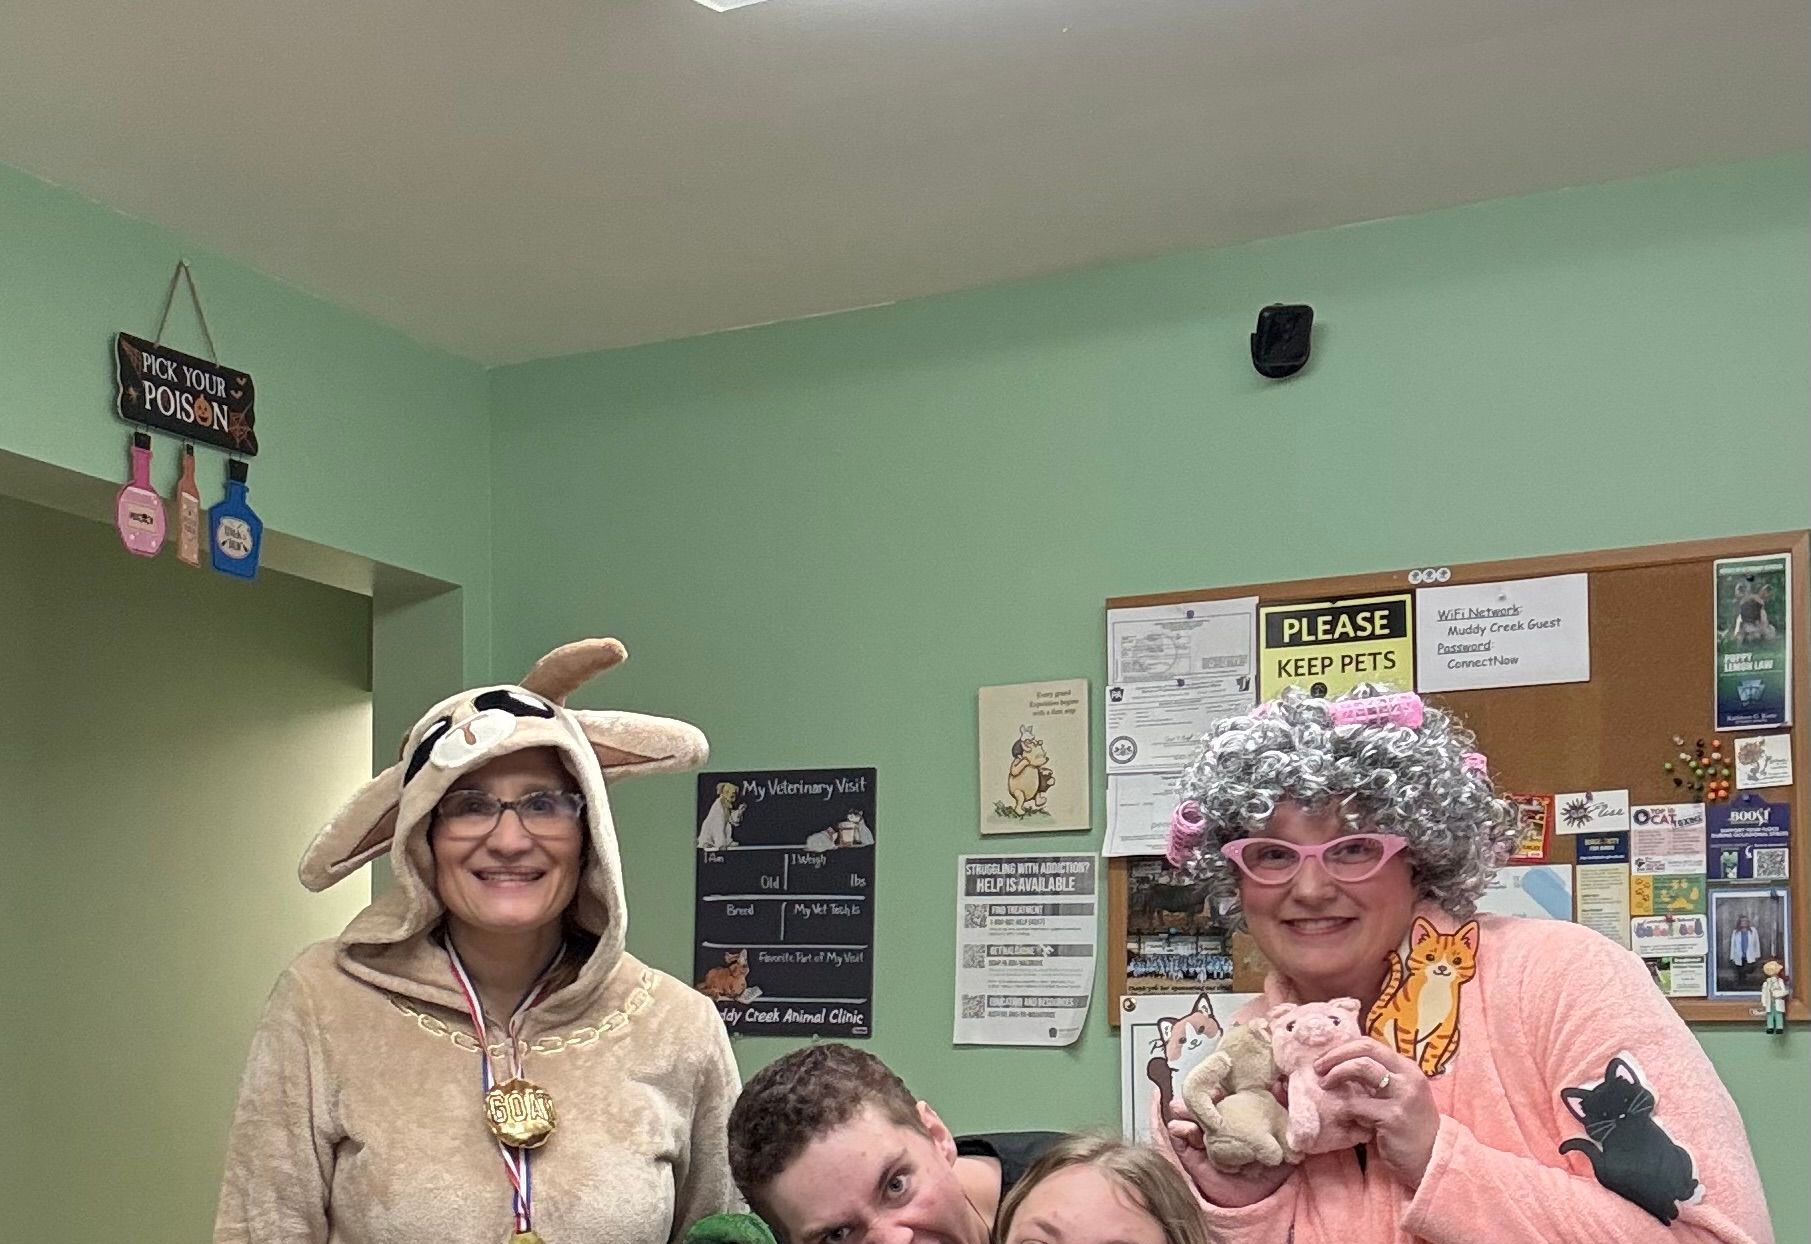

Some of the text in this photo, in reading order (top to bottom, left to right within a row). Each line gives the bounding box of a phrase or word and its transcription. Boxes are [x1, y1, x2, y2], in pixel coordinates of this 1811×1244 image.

[142, 352, 227, 398] PICK YOUR
[142, 380, 229, 433] POISON
[1438, 607, 1465, 621] WiFi
[1283, 609, 1391, 643] PLEASE
[1447, 617, 1562, 637] Muddy Creek Guest
[1277, 650, 1396, 678] KEEP PETS
[1447, 655, 1520, 670] ConnectNow
[1754, 660, 1773, 671] LAW
[742, 776, 867, 802] My Veterinary Visit
[1650, 814, 1677, 825] CAT
[709, 852, 725, 863] Am
[790, 853, 827, 869] I Weigh
[966, 861, 1090, 875] STRUGGLING WITH ADDICTION?
[760, 875, 780, 889] Old
[850, 873, 867, 888] lbs
[976, 877, 1076, 893] HELP IS AVAILABLE
[726, 904, 755, 916] Breed
[794, 904, 811, 919] My
[812, 903, 828, 915] Vet
[758, 951, 864, 967] Favorite Part of My Visit
[720, 1007, 864, 1026] ddy Creek Animal Clinic
